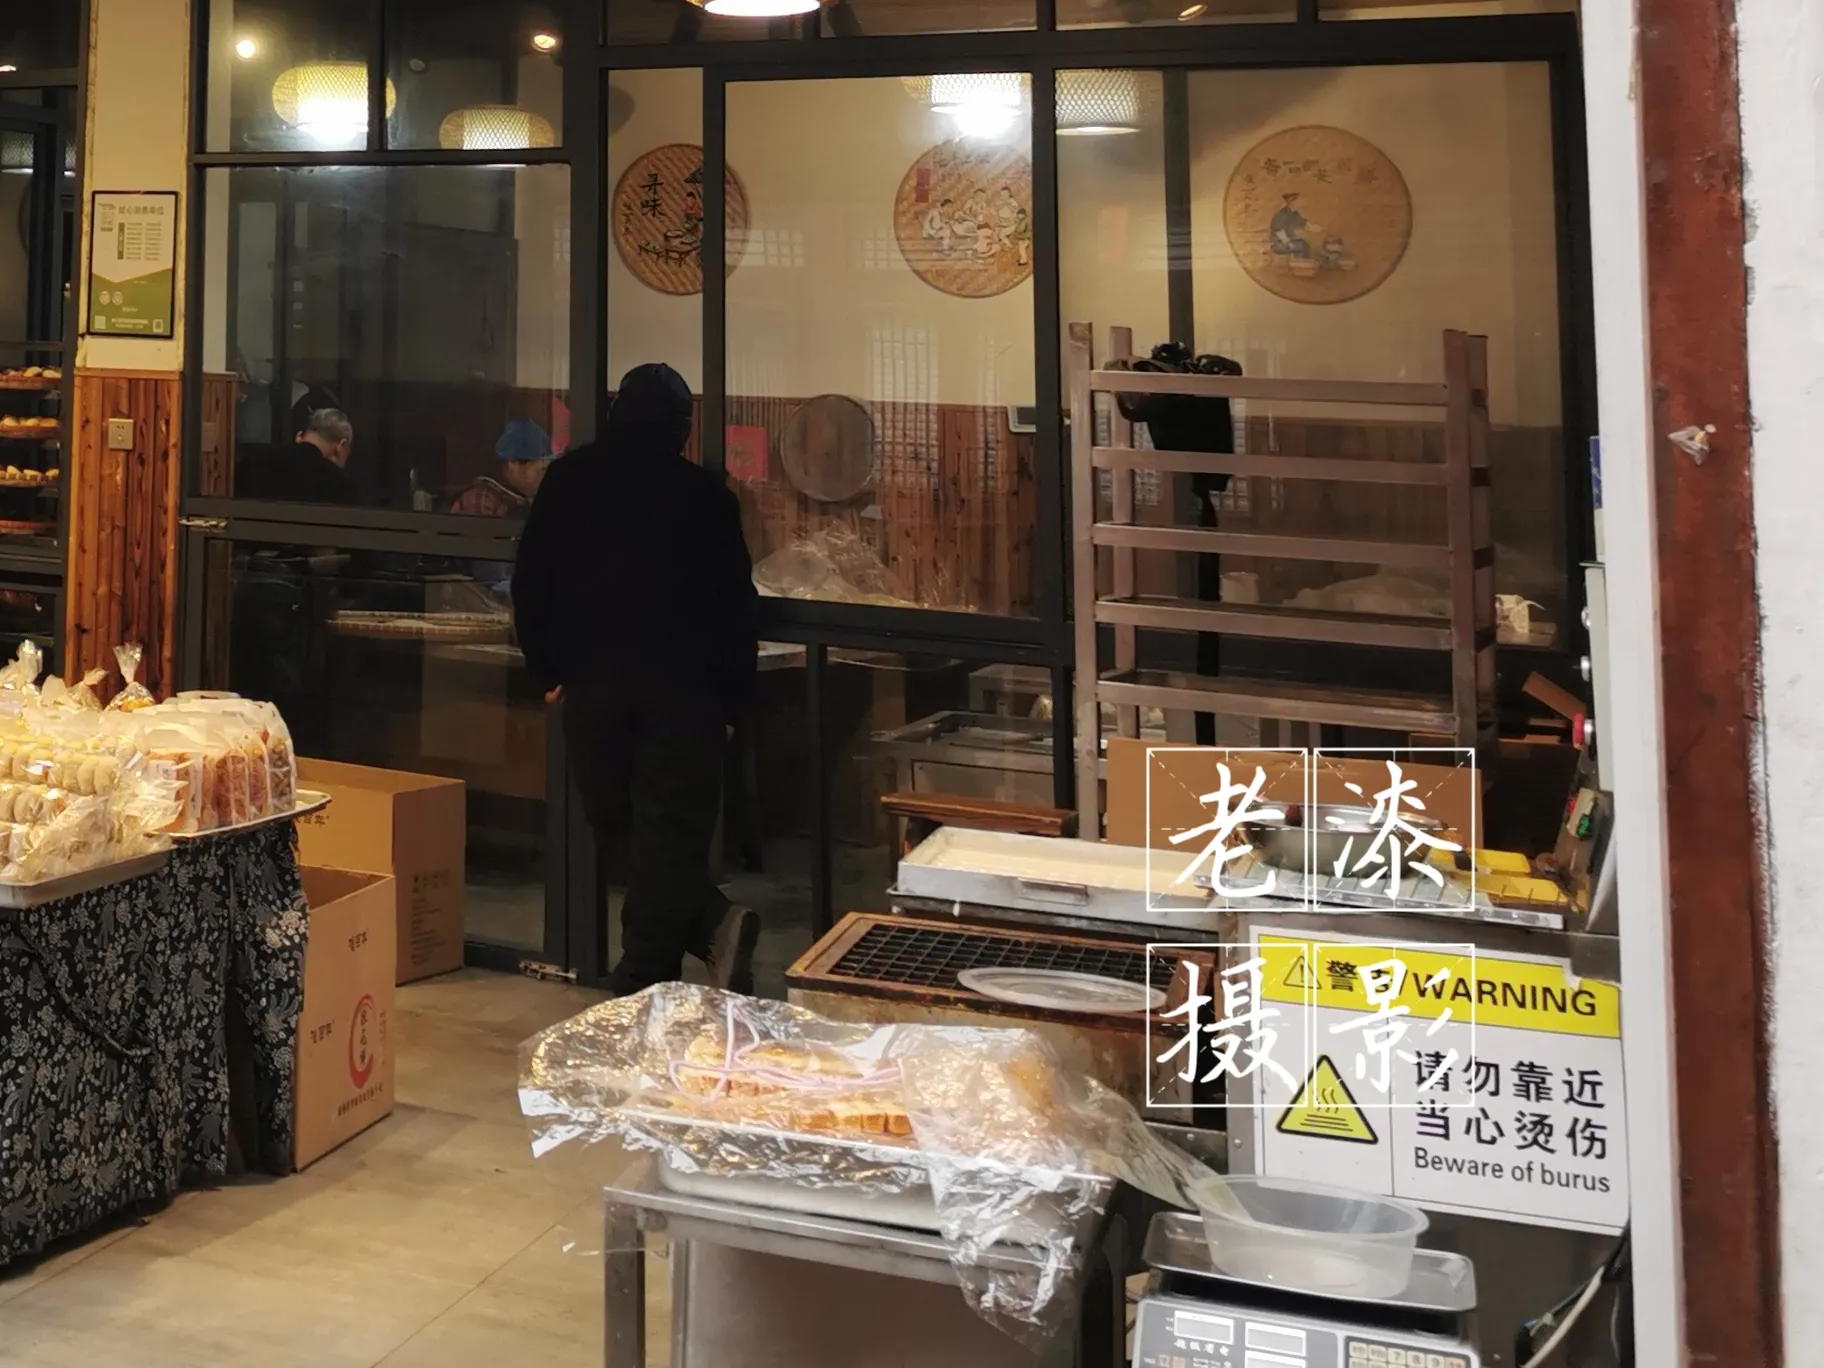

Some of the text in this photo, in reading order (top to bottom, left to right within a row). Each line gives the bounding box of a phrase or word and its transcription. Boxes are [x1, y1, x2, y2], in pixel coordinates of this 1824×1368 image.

[1414, 1050, 1606, 1109] 请勿靠近
[1415, 1098, 1609, 1161] 当心烫伤
[1414, 1147, 1611, 1193] Beware of burus
